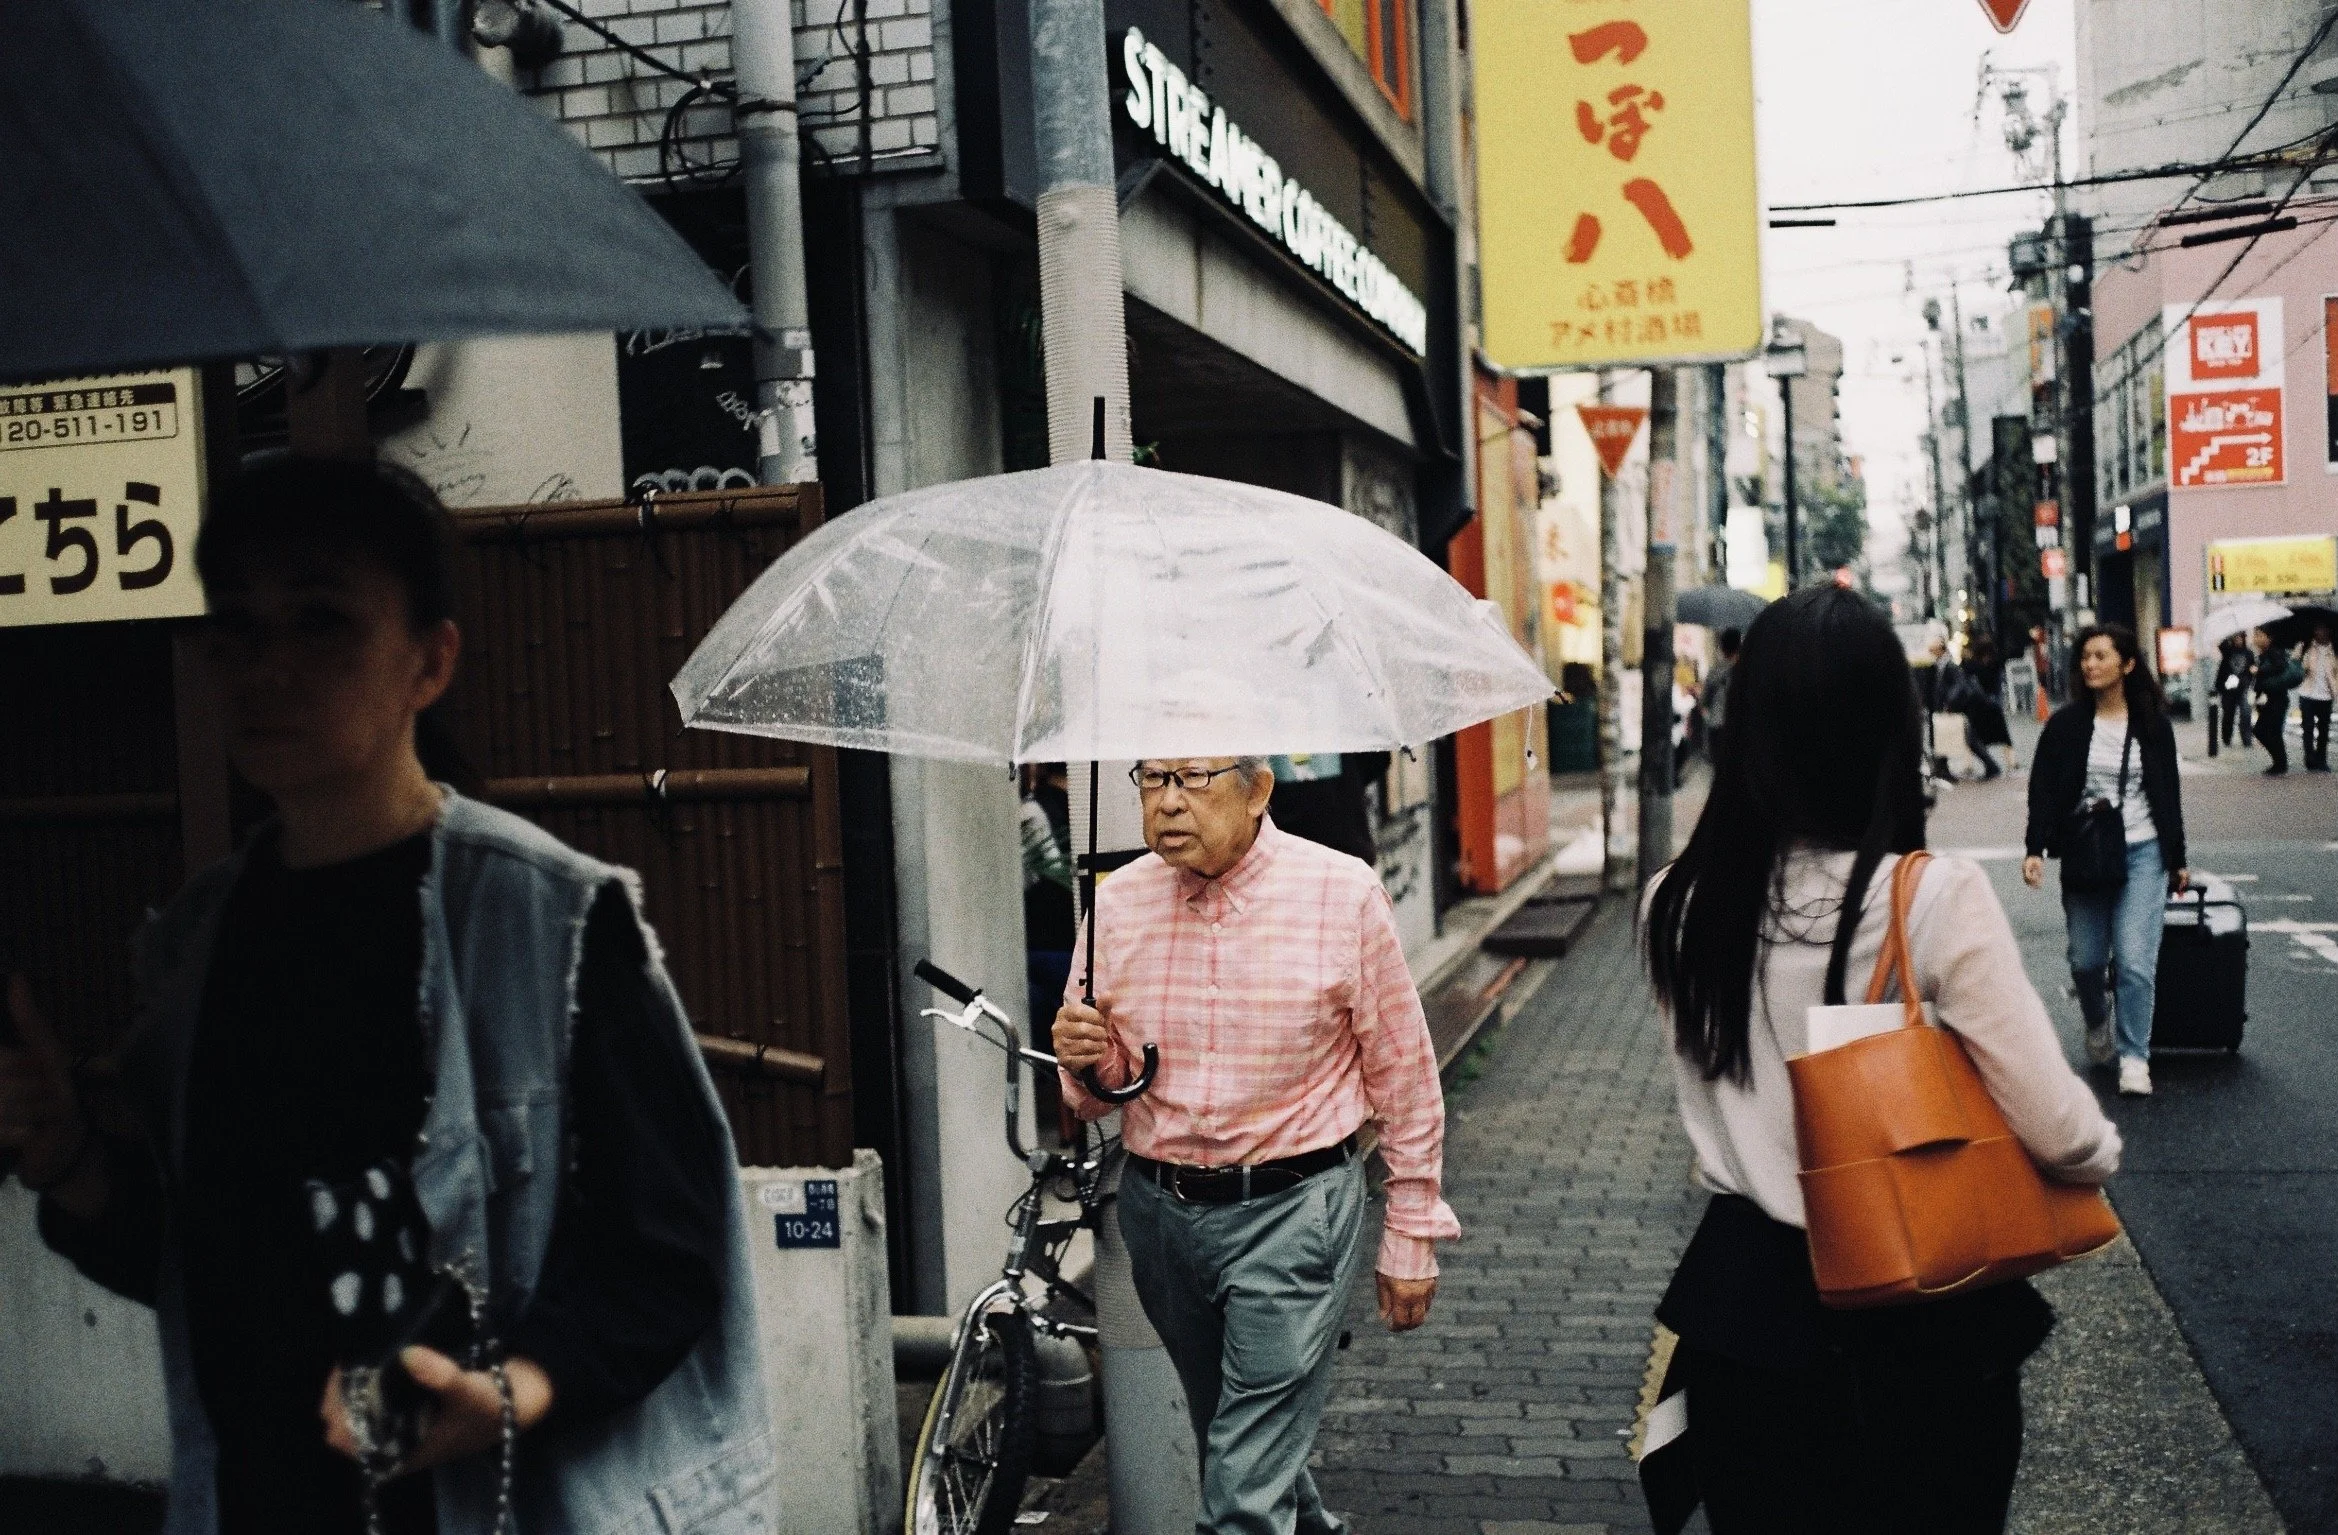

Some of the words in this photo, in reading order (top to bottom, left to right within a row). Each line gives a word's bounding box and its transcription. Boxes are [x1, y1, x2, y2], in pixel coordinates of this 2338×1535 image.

[1561, 20, 1694, 264] つぼ八
[0, 409, 163, 443] 20-511-191
[2246, 446, 2274, 467] 2F
[785, 1220, 834, 1239] 10-24
